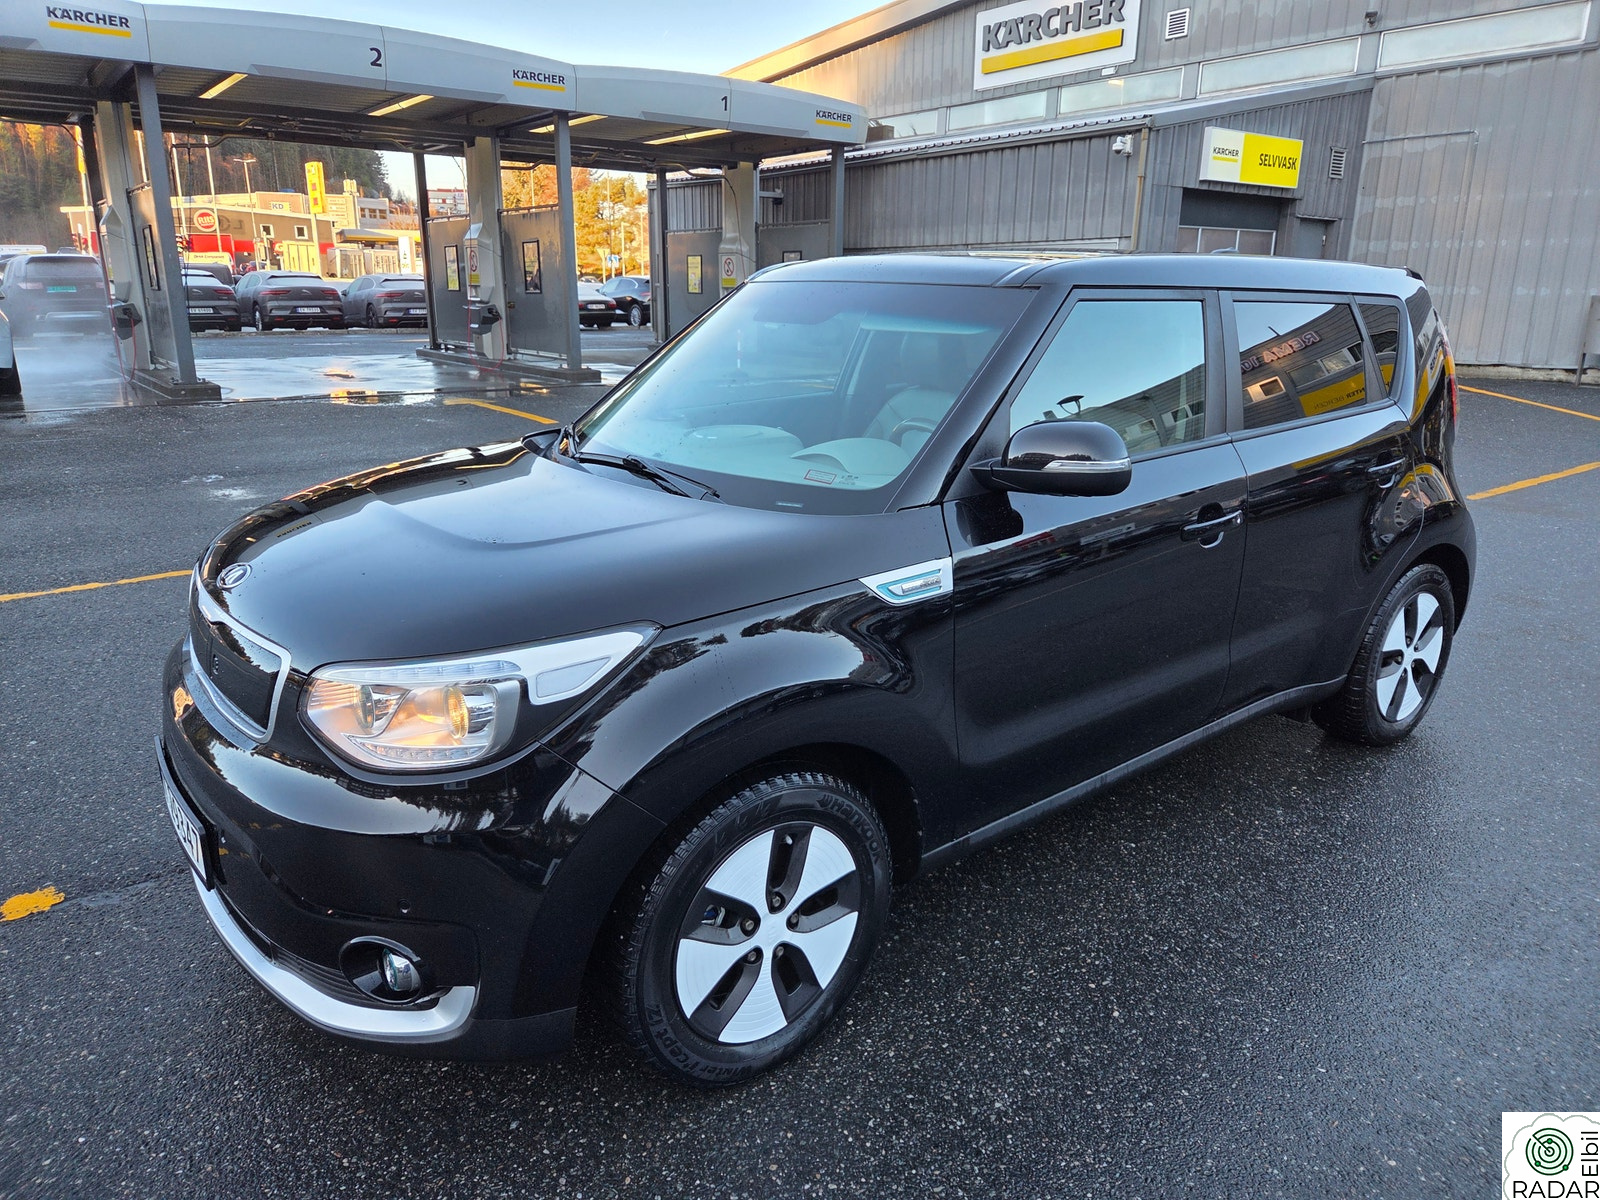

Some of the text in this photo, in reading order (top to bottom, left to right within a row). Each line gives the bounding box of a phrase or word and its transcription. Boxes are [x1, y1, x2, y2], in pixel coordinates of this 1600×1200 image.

[46, 6, 131, 28] KÄRCHER
[982, 0, 1125, 52] KÄRCHER
[369, 47, 382, 68] 2
[512, 69, 565, 85] KÄRCHER
[721, 95, 728, 111] 1
[815, 109, 852, 122] KÄRCHER
[1213, 146, 1240, 157] KÄRCHER
[1258, 153, 1298, 170] SELVVASK
